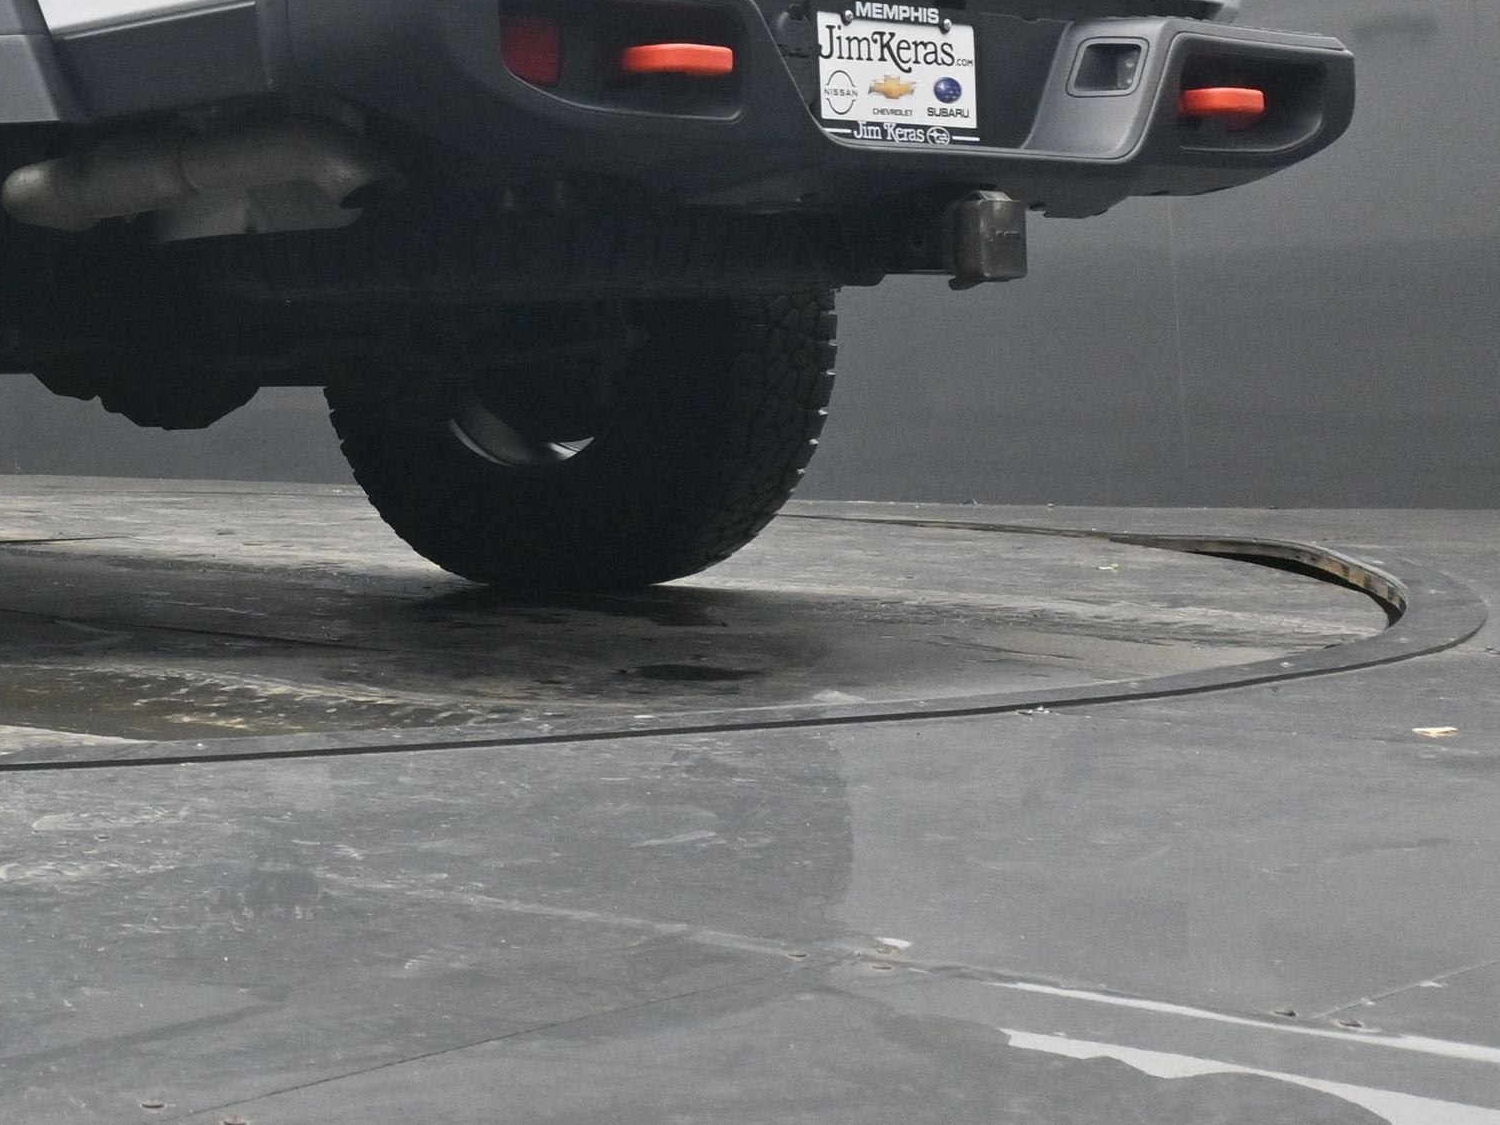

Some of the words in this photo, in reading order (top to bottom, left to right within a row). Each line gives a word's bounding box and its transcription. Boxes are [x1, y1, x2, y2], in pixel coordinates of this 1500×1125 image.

[855, 1, 939, 24] MEMPHIS
[824, 88, 858, 97] NISSAN
[873, 108, 913, 117] CHEVROLET
[927, 107, 970, 118] SUBARU
[853, 121, 882, 140] Jim
[883, 122, 924, 143] Keras
